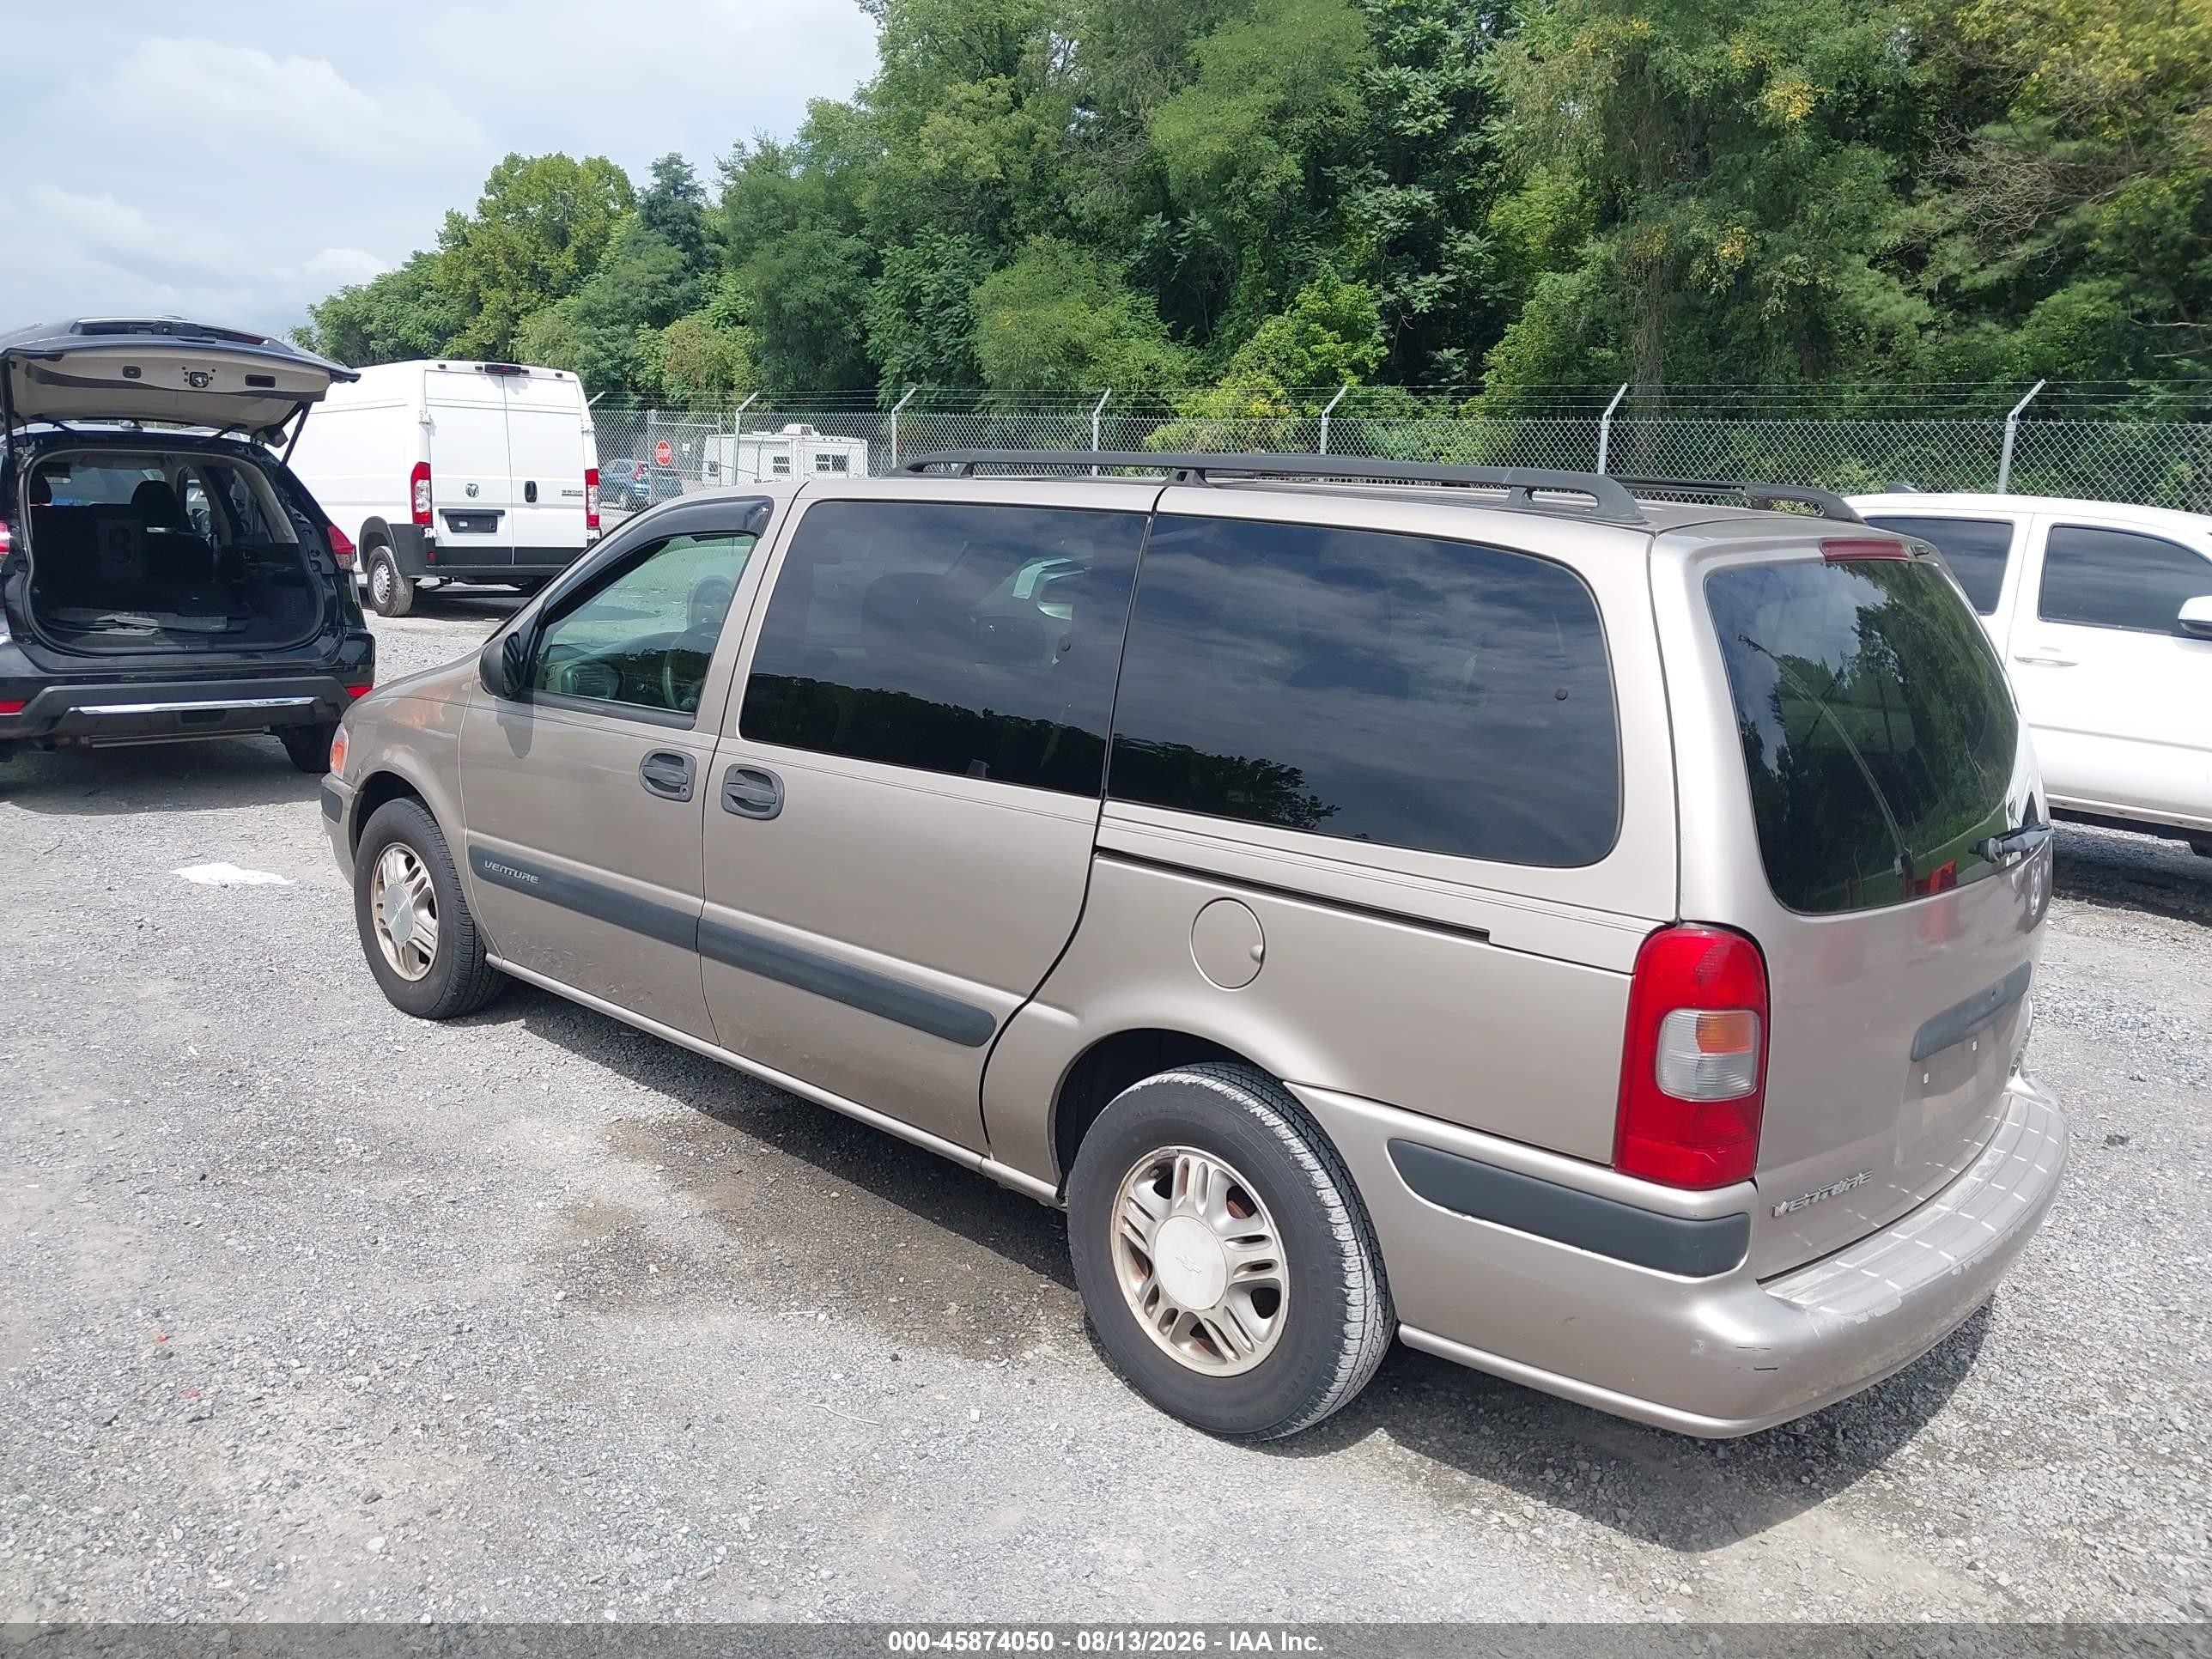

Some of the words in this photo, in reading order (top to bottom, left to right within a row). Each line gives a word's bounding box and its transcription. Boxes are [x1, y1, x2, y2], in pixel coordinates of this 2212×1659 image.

[657, 448, 672, 459] STOP
[484, 860, 539, 884] VENTURE
[1771, 1169, 1874, 1218] VENTURE
